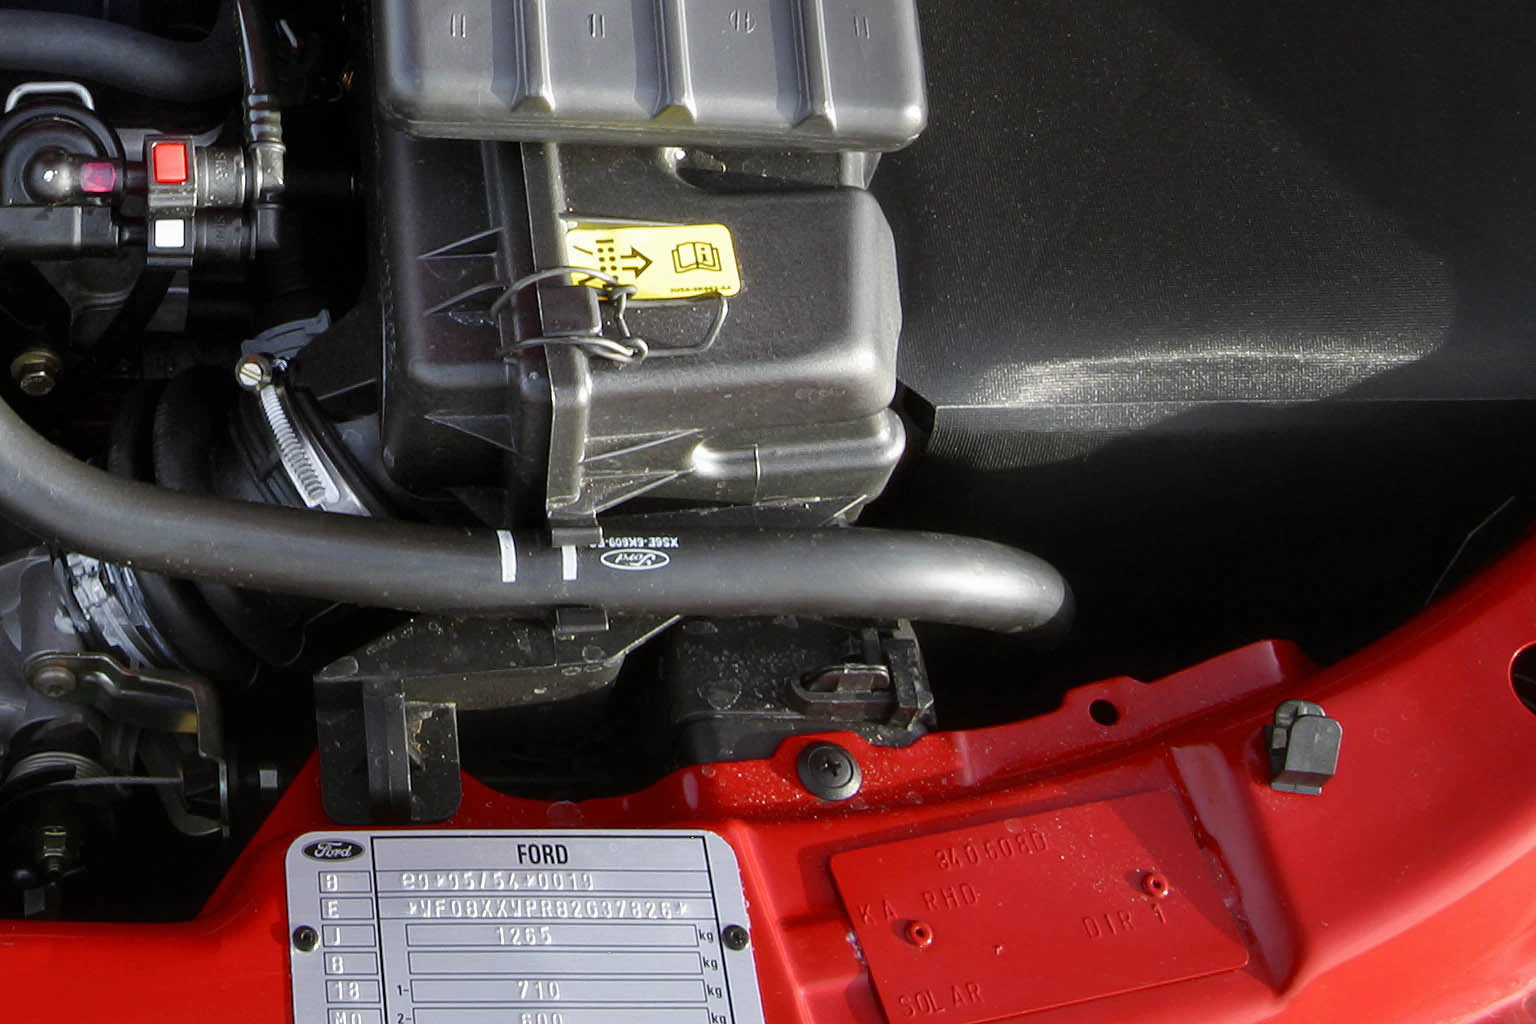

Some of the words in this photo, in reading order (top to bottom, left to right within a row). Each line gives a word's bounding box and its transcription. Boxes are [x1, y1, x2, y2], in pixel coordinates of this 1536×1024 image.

[517, 843, 569, 865] FORD
[328, 900, 340, 919] E
[1082, 910, 1135, 940] DIR
[496, 926, 554, 946] 1265
[699, 929, 714, 945] kg
[703, 957, 718, 971] kg
[518, 980, 562, 1000] 710
[707, 984, 722, 999] kg
[711, 1012, 727, 1024] kg
